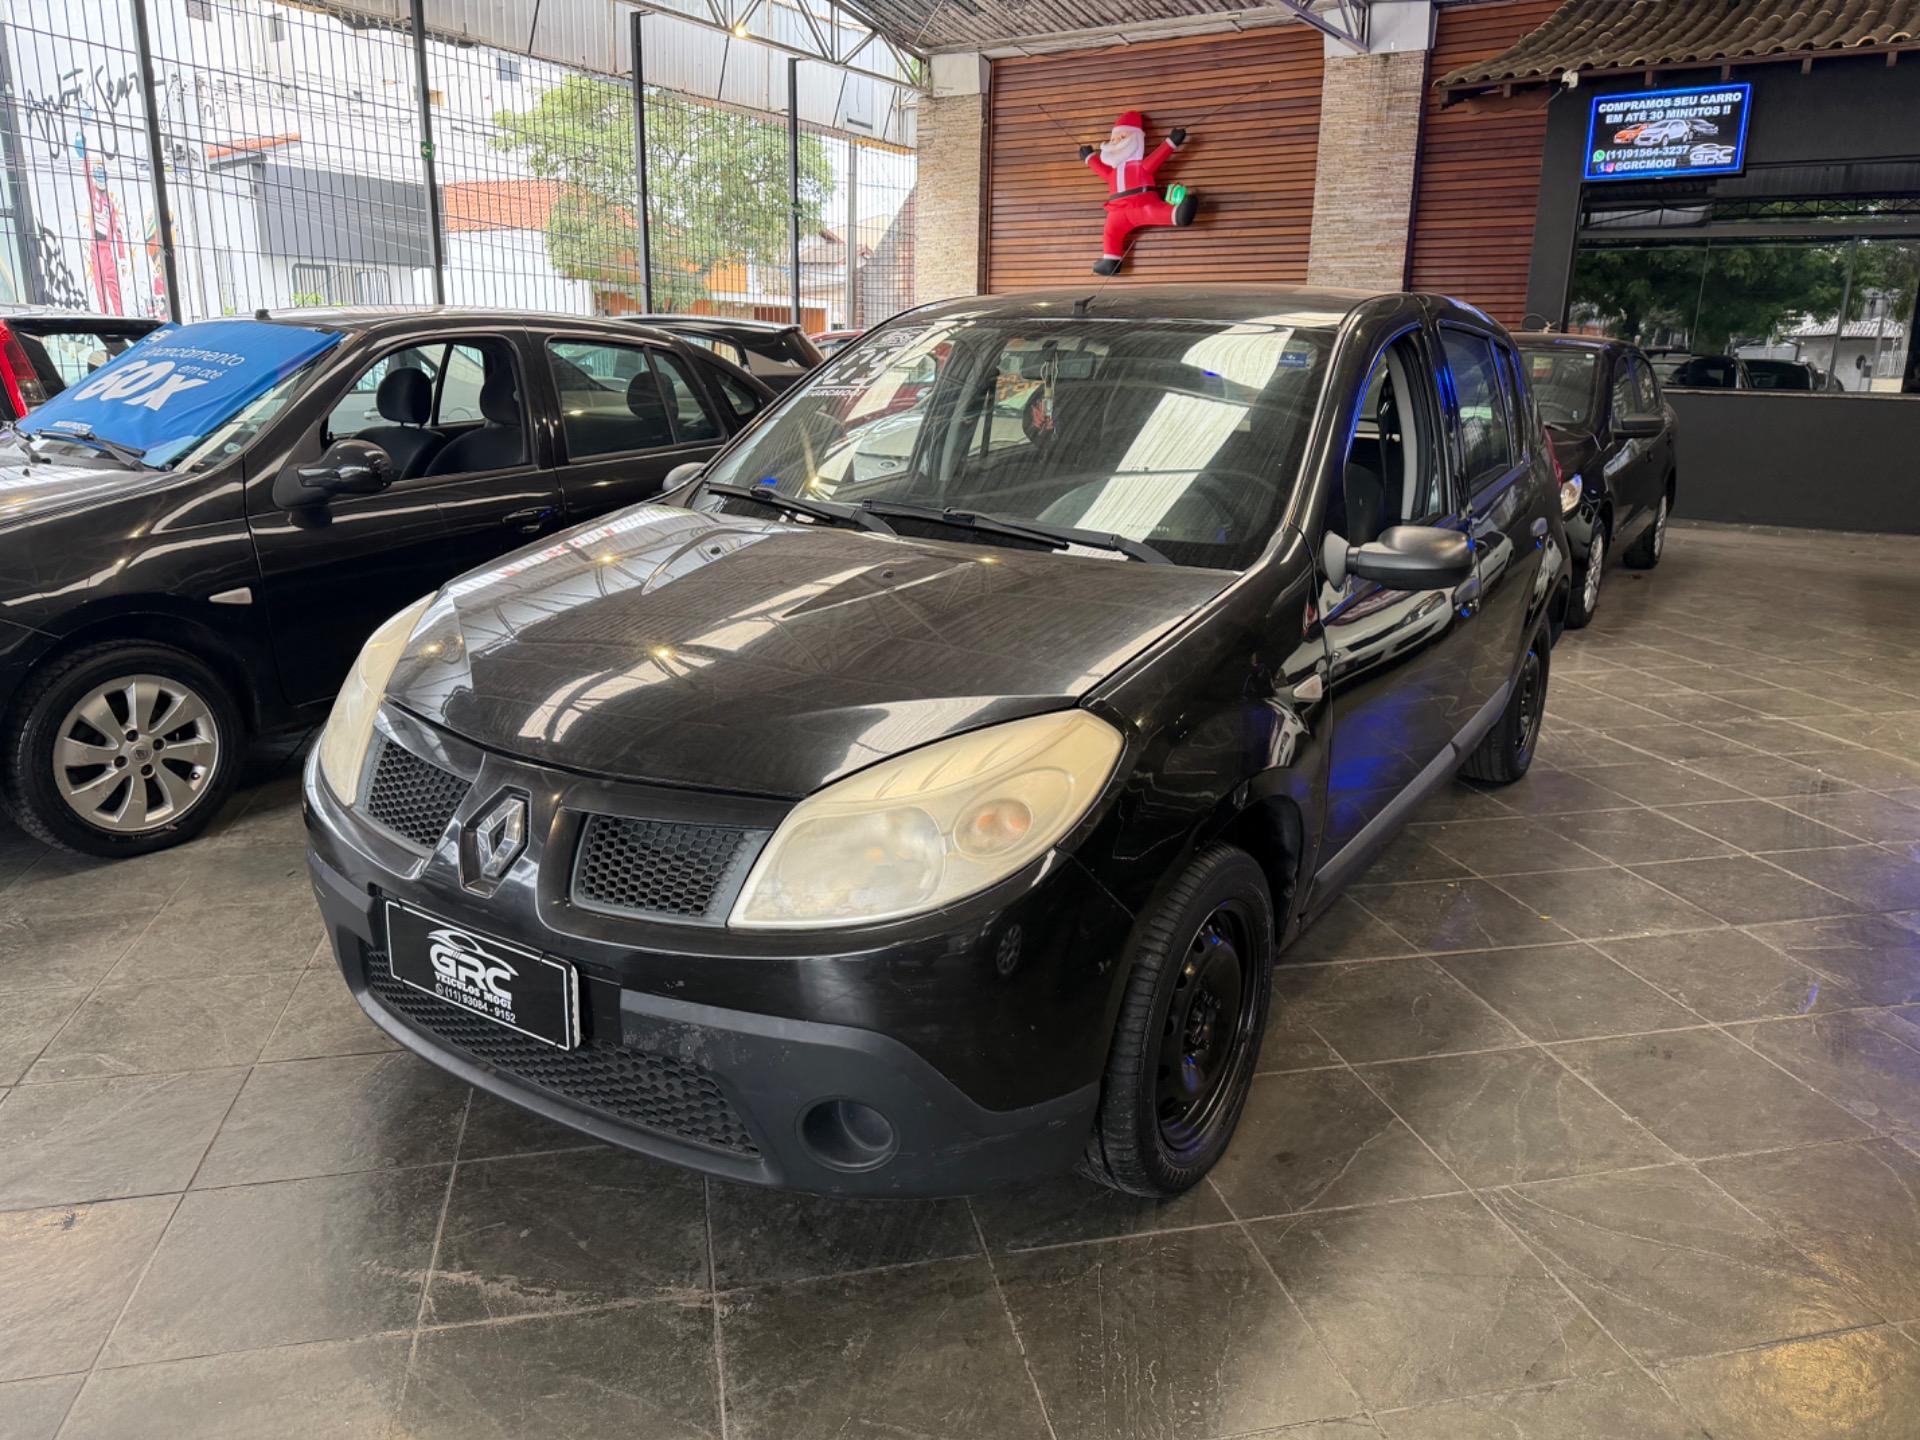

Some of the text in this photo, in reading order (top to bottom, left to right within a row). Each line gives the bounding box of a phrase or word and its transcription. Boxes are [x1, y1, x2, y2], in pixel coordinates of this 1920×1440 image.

[1598, 92, 1742, 113] COMPRAMOS SEU CARRO
[1606, 113, 1622, 124] EM
[1624, 110, 1647, 122] ATÉ
[1649, 110, 1663, 120] 30
[1665, 106, 1720, 118] MINUTOS
[1690, 149, 1732, 161] GRC
[429, 943, 512, 1002] GRC
[444, 985, 461, 1003] (11)
[483, 991, 512, 1010] MOGI
